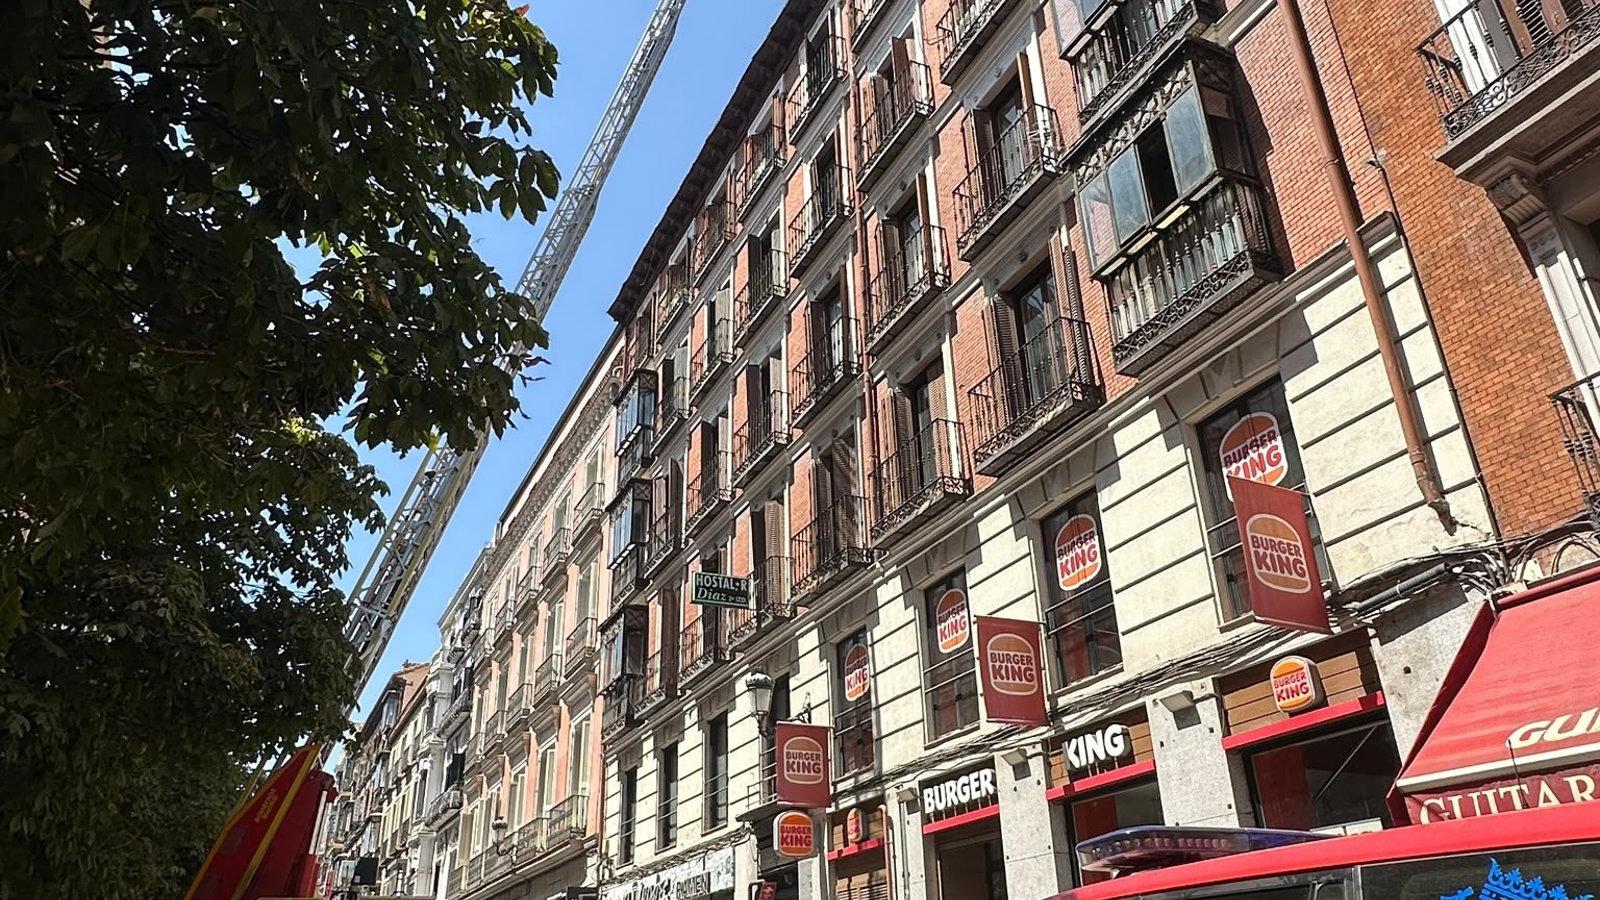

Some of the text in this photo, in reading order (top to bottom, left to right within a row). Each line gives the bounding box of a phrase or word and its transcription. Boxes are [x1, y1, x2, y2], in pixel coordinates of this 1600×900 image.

[1223, 429, 1279, 468] BURGER
[1057, 529, 1096, 560] BURGER
[1250, 534, 1301, 558] BURGER
[1059, 543, 1098, 578] KING
[1253, 550, 1307, 579] KING
[940, 614, 967, 642] KING
[990, 651, 1034, 667] BURGER
[846, 667, 869, 691] KING
[991, 663, 1035, 683] KING
[1273, 671, 1307, 689] BURGER
[1275, 681, 1309, 702] KING
[785, 750, 822, 762] BURGER
[1063, 723, 1127, 770] KING
[785, 760, 823, 774] KING
[923, 768, 996, 814] BURGER
[780, 824, 813, 836] BURGER
[780, 834, 813, 848] KING
